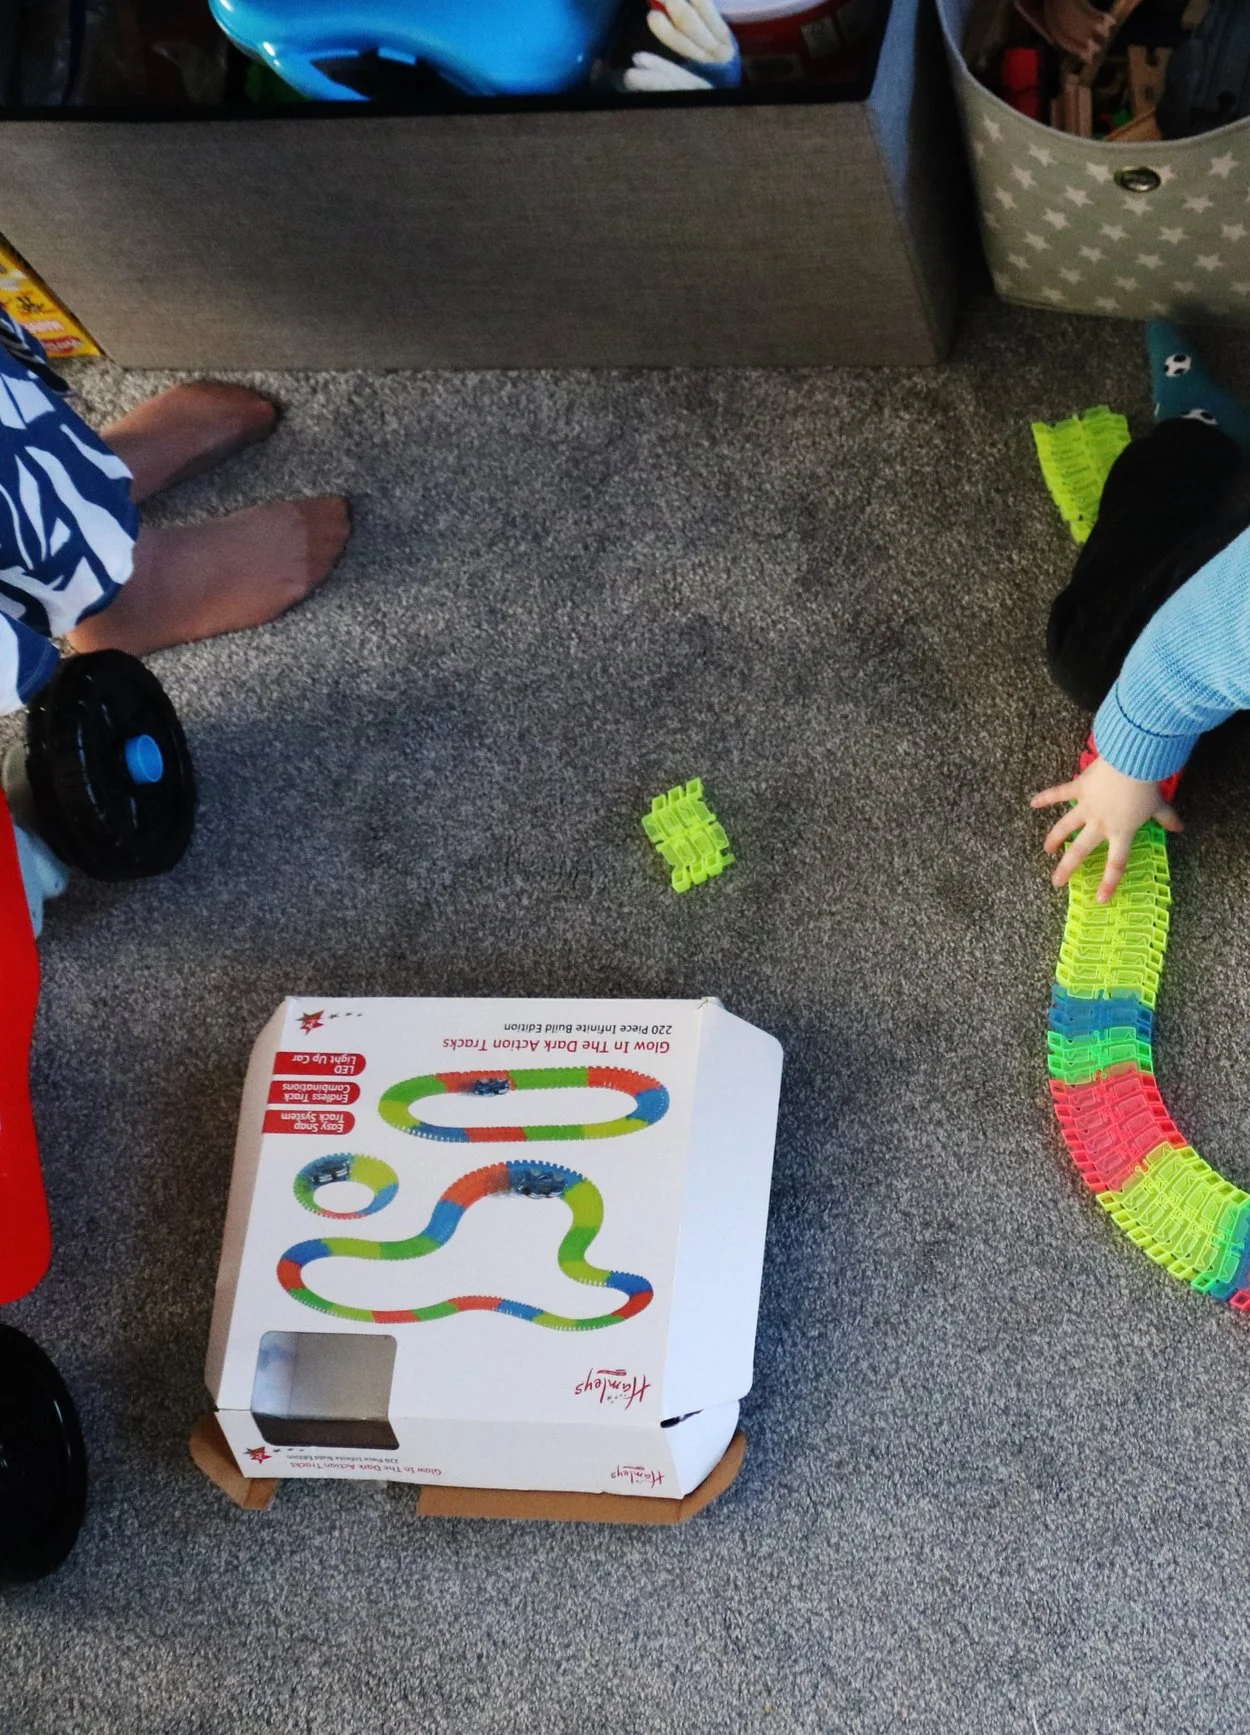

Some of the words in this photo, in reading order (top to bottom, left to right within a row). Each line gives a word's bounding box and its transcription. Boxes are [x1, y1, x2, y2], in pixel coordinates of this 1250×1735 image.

[504, 1023, 542, 1033] Edition
[545, 1024, 573, 1034] Build
[576, 1024, 617, 1035] Infinite
[620, 1025, 648, 1035] Piece
[652, 1025, 672, 1035] 220
[443, 1038, 488, 1052] Tracks
[493, 1039, 540, 1052] Action
[544, 1039, 578, 1053] Dark
[582, 1040, 609, 1053] The
[614, 1041, 629, 1054] In
[634, 1041, 670, 1054] Glow
[292, 1055, 310, 1064] Car
[312, 1053, 327, 1064] Up
[331, 1053, 357, 1065] Light
[334, 1065, 354, 1074] LED
[282, 1083, 351, 1093] Combinations
[284, 1093, 309, 1102] Track
[312, 1093, 349, 1103] Endless
[281, 1111, 317, 1122] System
[319, 1113, 345, 1123] Track
[294, 1121, 319, 1132] Snap
[321, 1121, 344, 1133] Easy
[574, 1367, 651, 1410] Hamleys
[324, 1462, 355, 1470] Action
[417, 1467, 442, 1475] Glow
[610, 1464, 665, 1488] Hamleys
